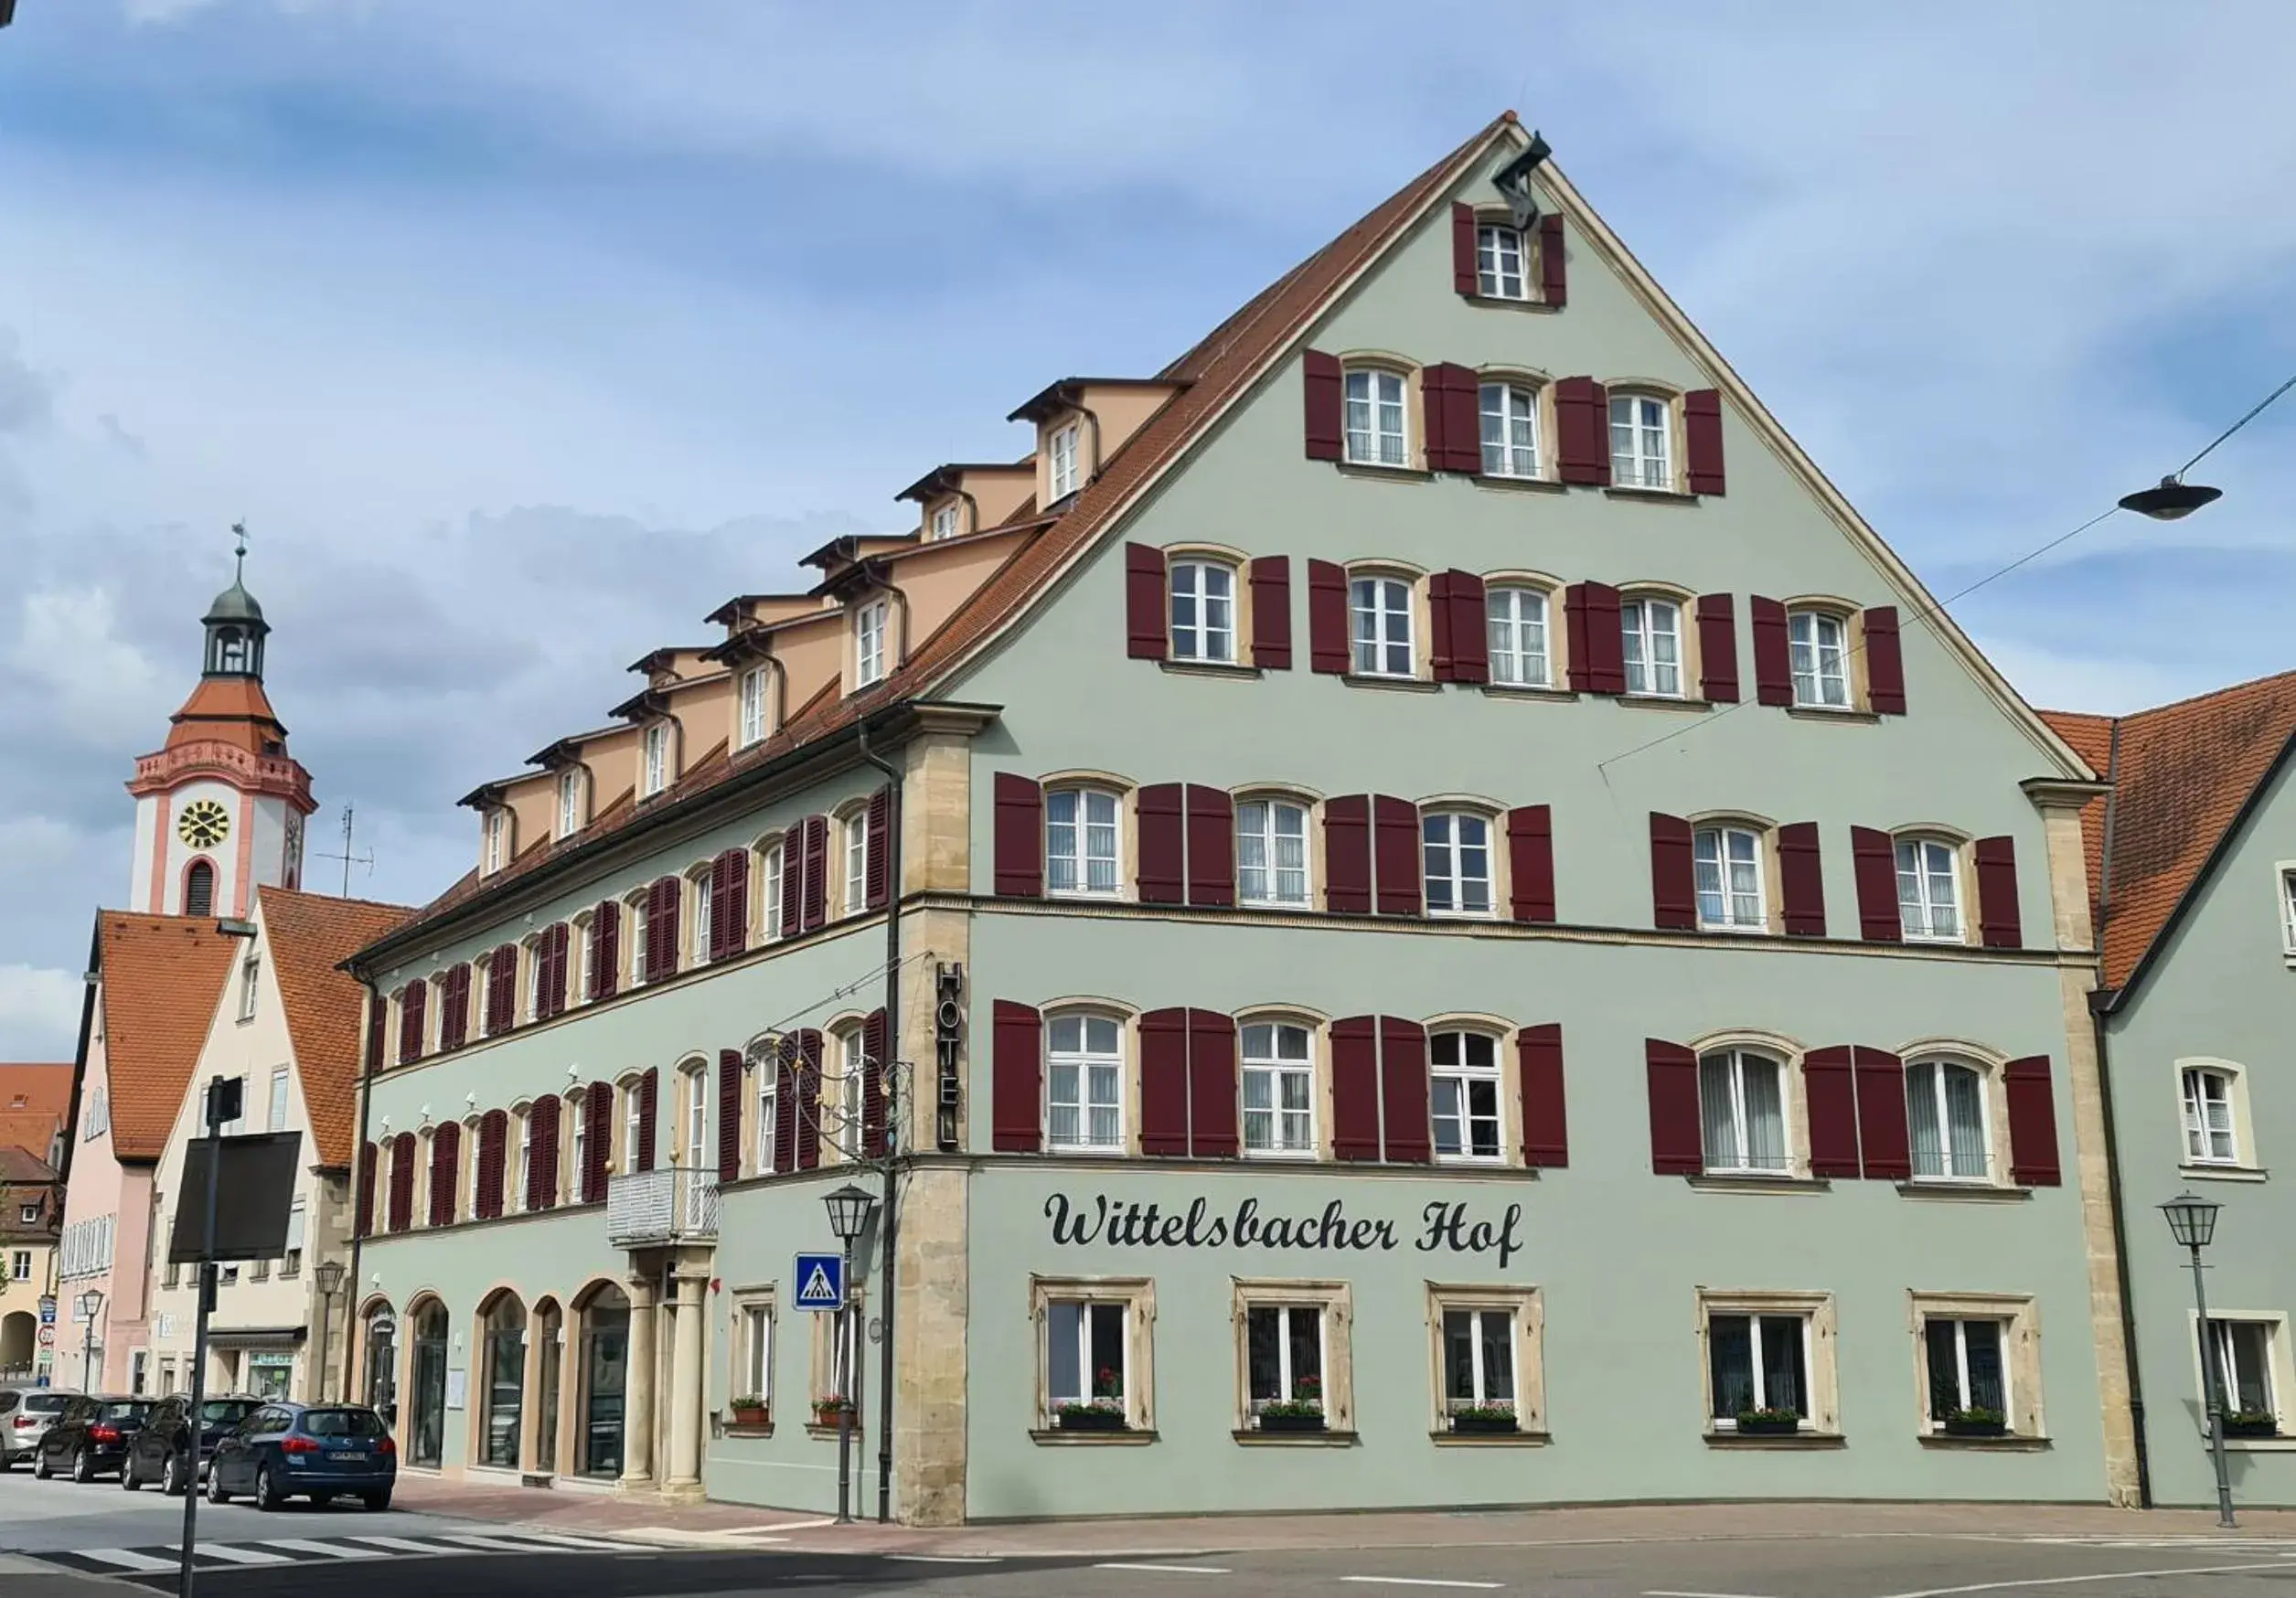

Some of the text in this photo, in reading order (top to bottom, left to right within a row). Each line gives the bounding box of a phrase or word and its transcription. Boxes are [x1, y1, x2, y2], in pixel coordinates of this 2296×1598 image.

[936, 963, 962, 1150] HOTEL
[1043, 1193, 1523, 1269] Wittelsbacher Hof
